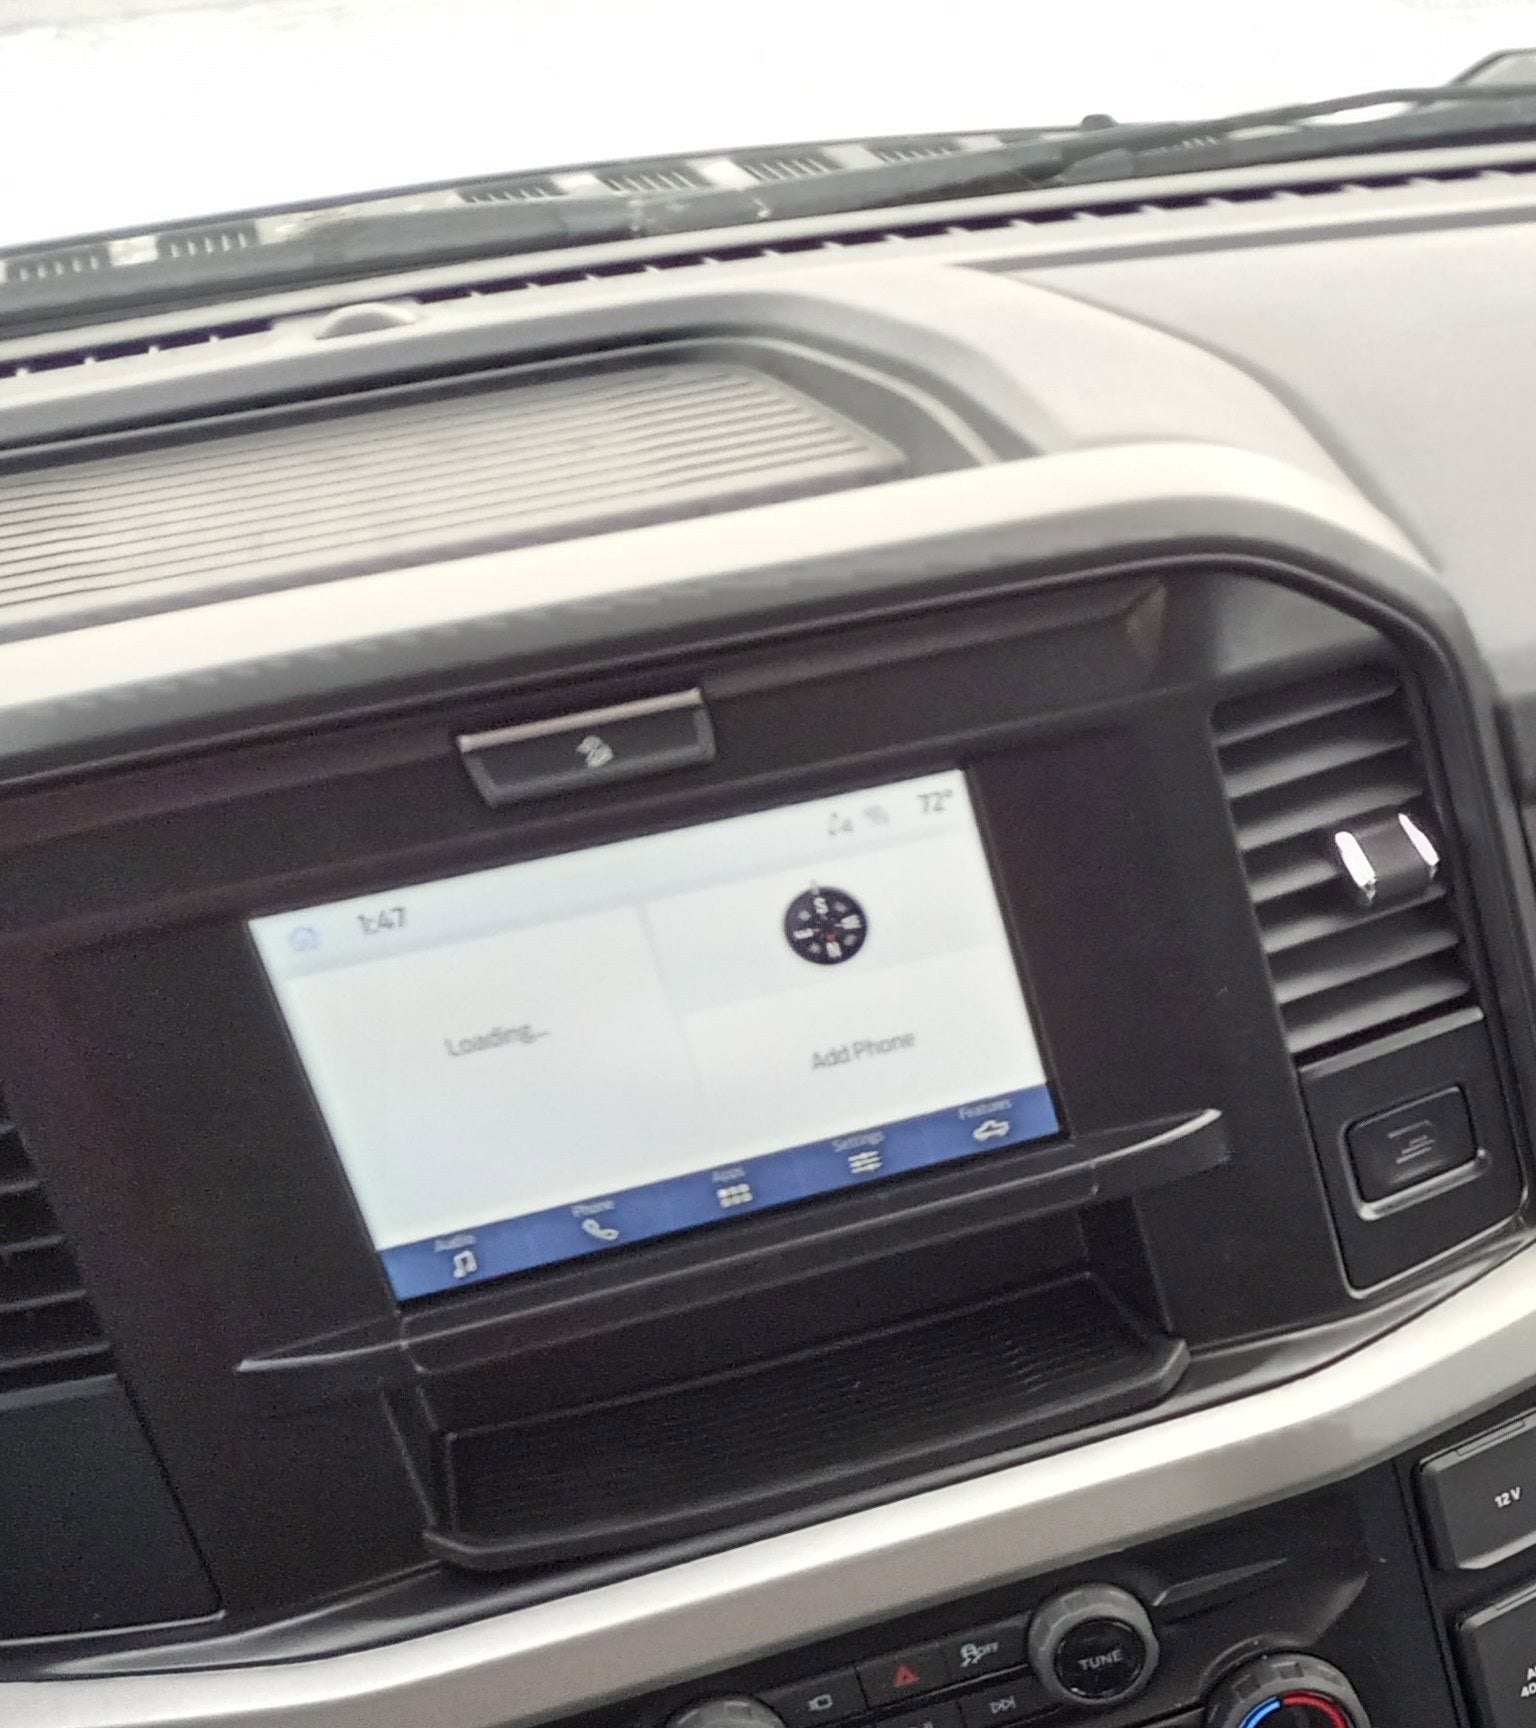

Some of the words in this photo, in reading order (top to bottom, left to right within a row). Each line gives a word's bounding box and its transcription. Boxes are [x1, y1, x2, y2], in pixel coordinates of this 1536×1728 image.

[357, 906, 407, 935] 1:47
[811, 1047, 852, 1070] Add
[852, 1032, 916, 1060] Phone
[1077, 1649, 1123, 1671] TUNE
